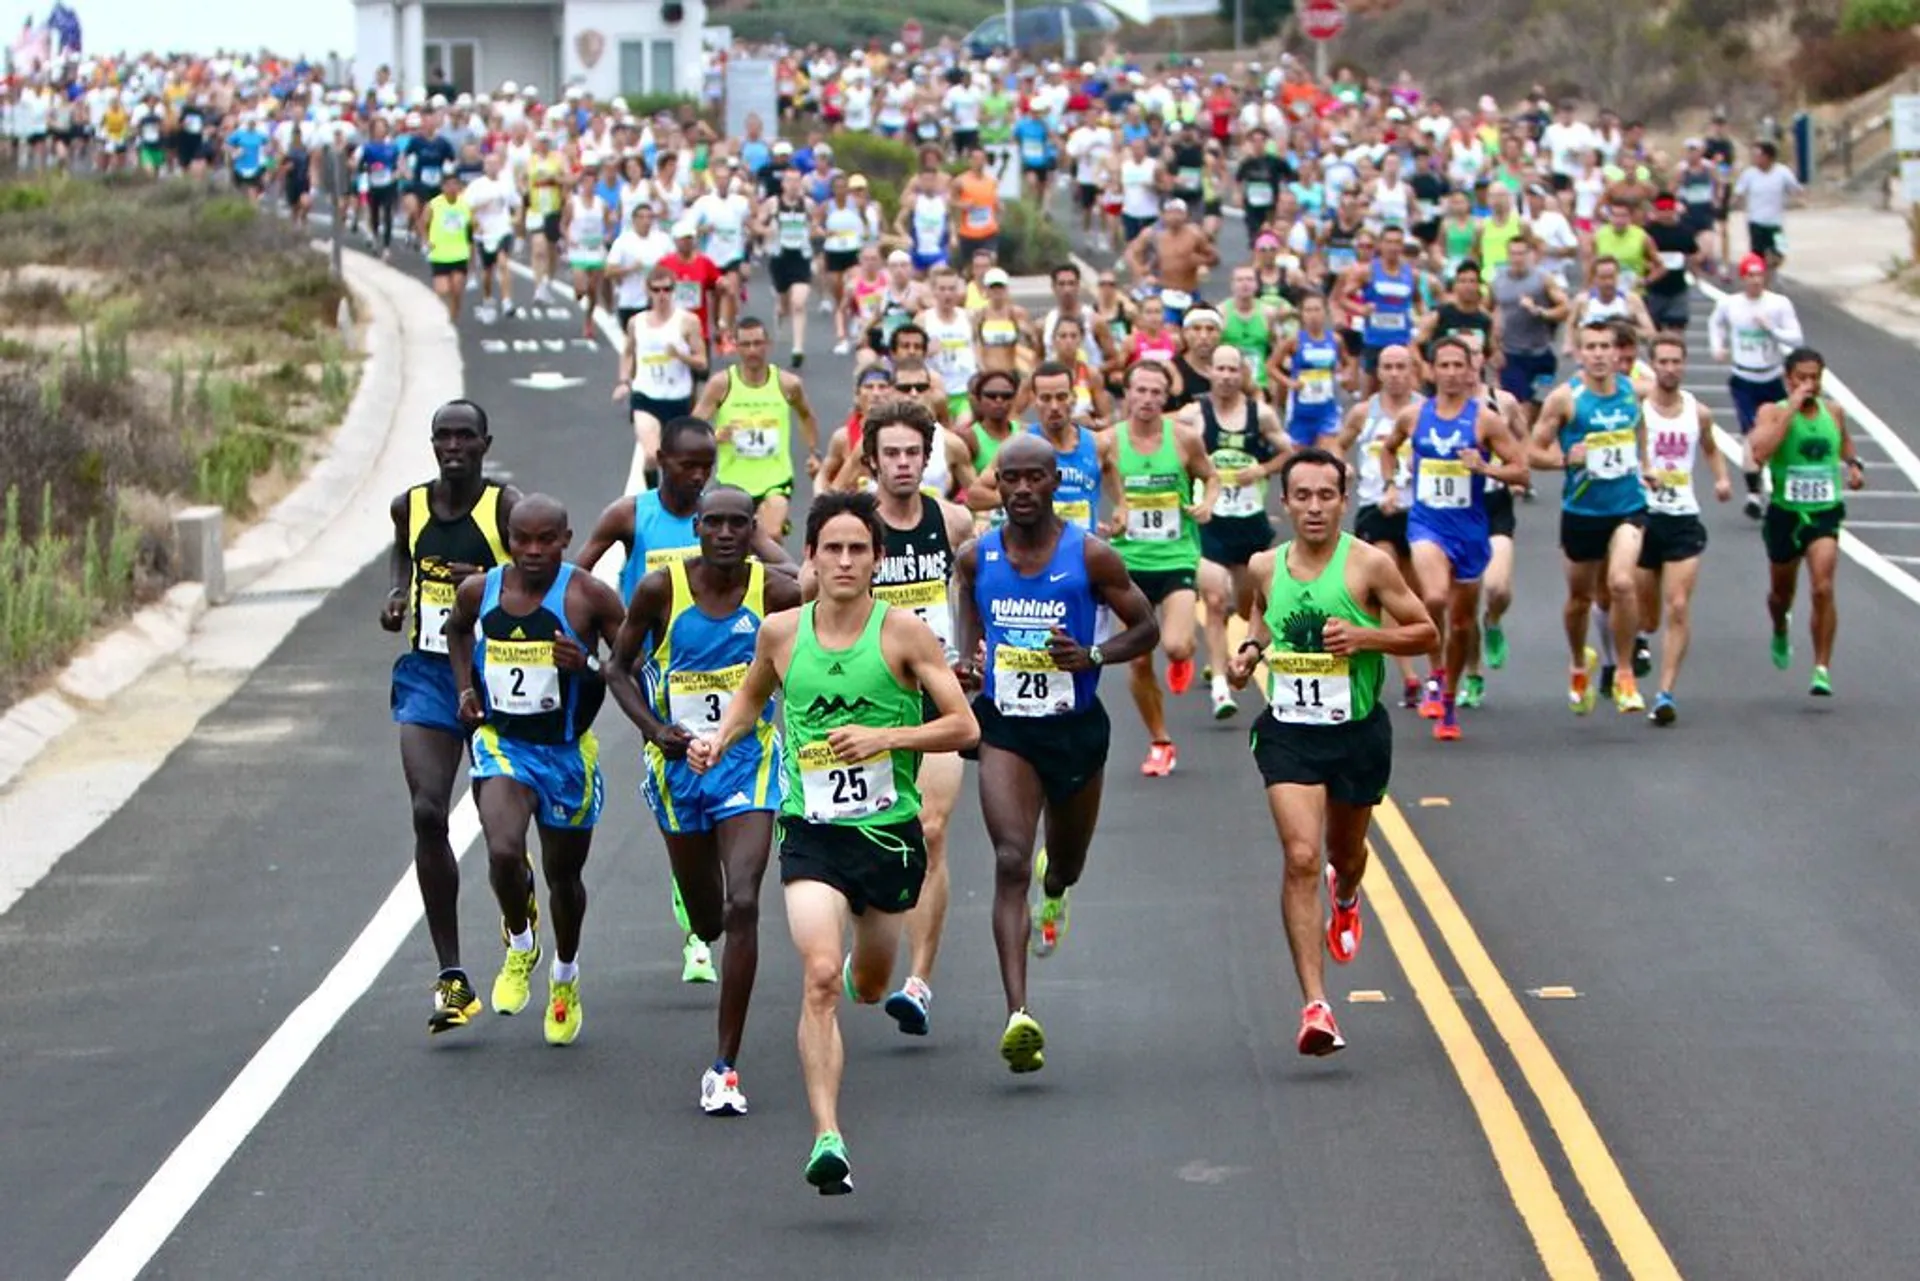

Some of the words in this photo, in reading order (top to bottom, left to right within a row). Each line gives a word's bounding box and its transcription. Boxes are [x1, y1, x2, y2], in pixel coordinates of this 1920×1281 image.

[1601, 447, 1622, 468] 24
[1434, 477, 1454, 497] 10
[1142, 510, 1163, 529] 18
[991, 598, 1066, 618] RUNNING
[510, 667, 526, 697] 2
[1016, 671, 1048, 699] 28
[1294, 679, 1324, 706] 11
[705, 694, 721, 722] 3
[828, 766, 868, 803] 25
